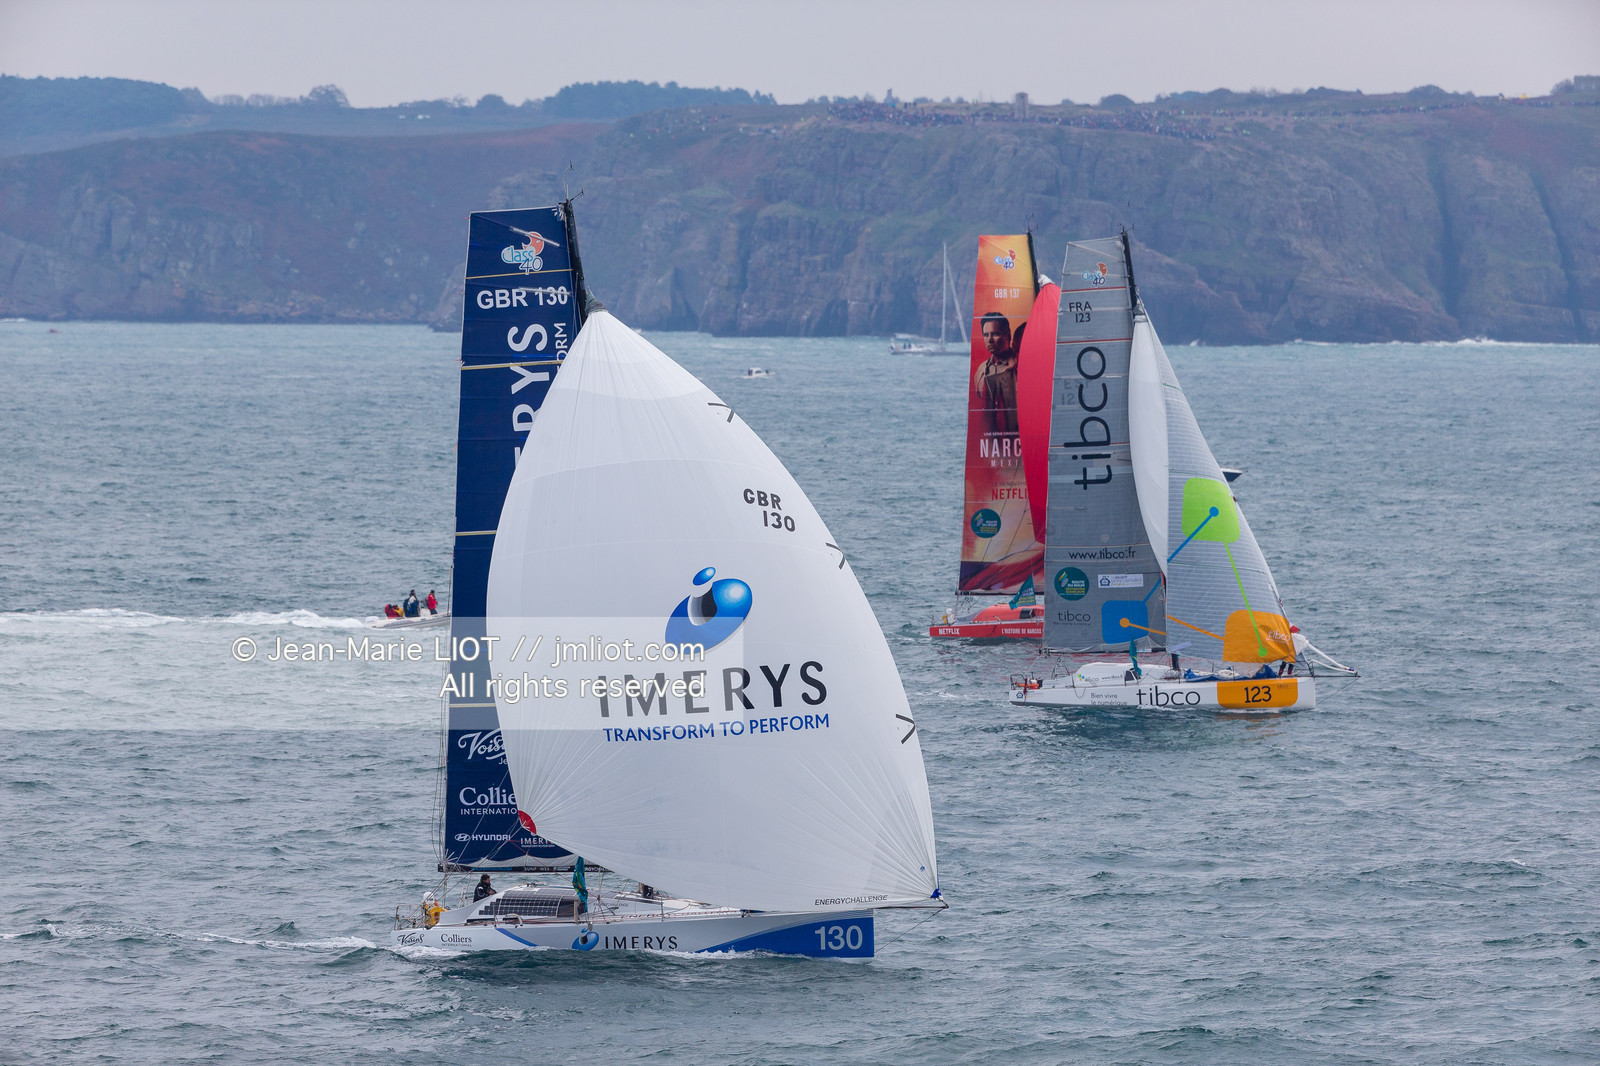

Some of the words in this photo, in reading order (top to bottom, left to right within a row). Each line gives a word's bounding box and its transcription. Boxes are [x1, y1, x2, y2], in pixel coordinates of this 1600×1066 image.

[502, 246, 534, 263] Class
[519, 257, 543, 275] 40
[1003, 261, 1015, 270] 40
[1081, 270, 1102, 281] Class
[1092, 276, 1106, 287] 40
[477, 288, 528, 309] GBR
[534, 286, 568, 306] 130
[994, 288, 1008, 299] GBR
[1009, 288, 1020, 299] 137
[1068, 301, 1092, 312] FRA
[1075, 313, 1091, 323] 123
[553, 322, 568, 371] ORM
[1063, 346, 1113, 490] tibco
[743, 488, 782, 511] GBR
[762, 511, 796, 532] 130
[1068, 546, 1136, 560] www.tibco.fr
[1057, 610, 1092, 622] tibco
[1268, 629, 1291, 642] tibco
[599, 660, 828, 718] IMERYS
[1136, 685, 1201, 706] tibco
[1244, 686, 1272, 703] 123
[603, 723, 715, 743] TRANSFORM
[719, 720, 745, 737] TO
[749, 713, 830, 735] PERFORM
[457, 727, 507, 761] Vois
[460, 807, 518, 815] INTERNATIO
[815, 895, 888, 906] ENERGYCHALLENGE
[440, 933, 473, 943] Colliers
[604, 935, 678, 950] IMERYS
[815, 925, 863, 950] 130
